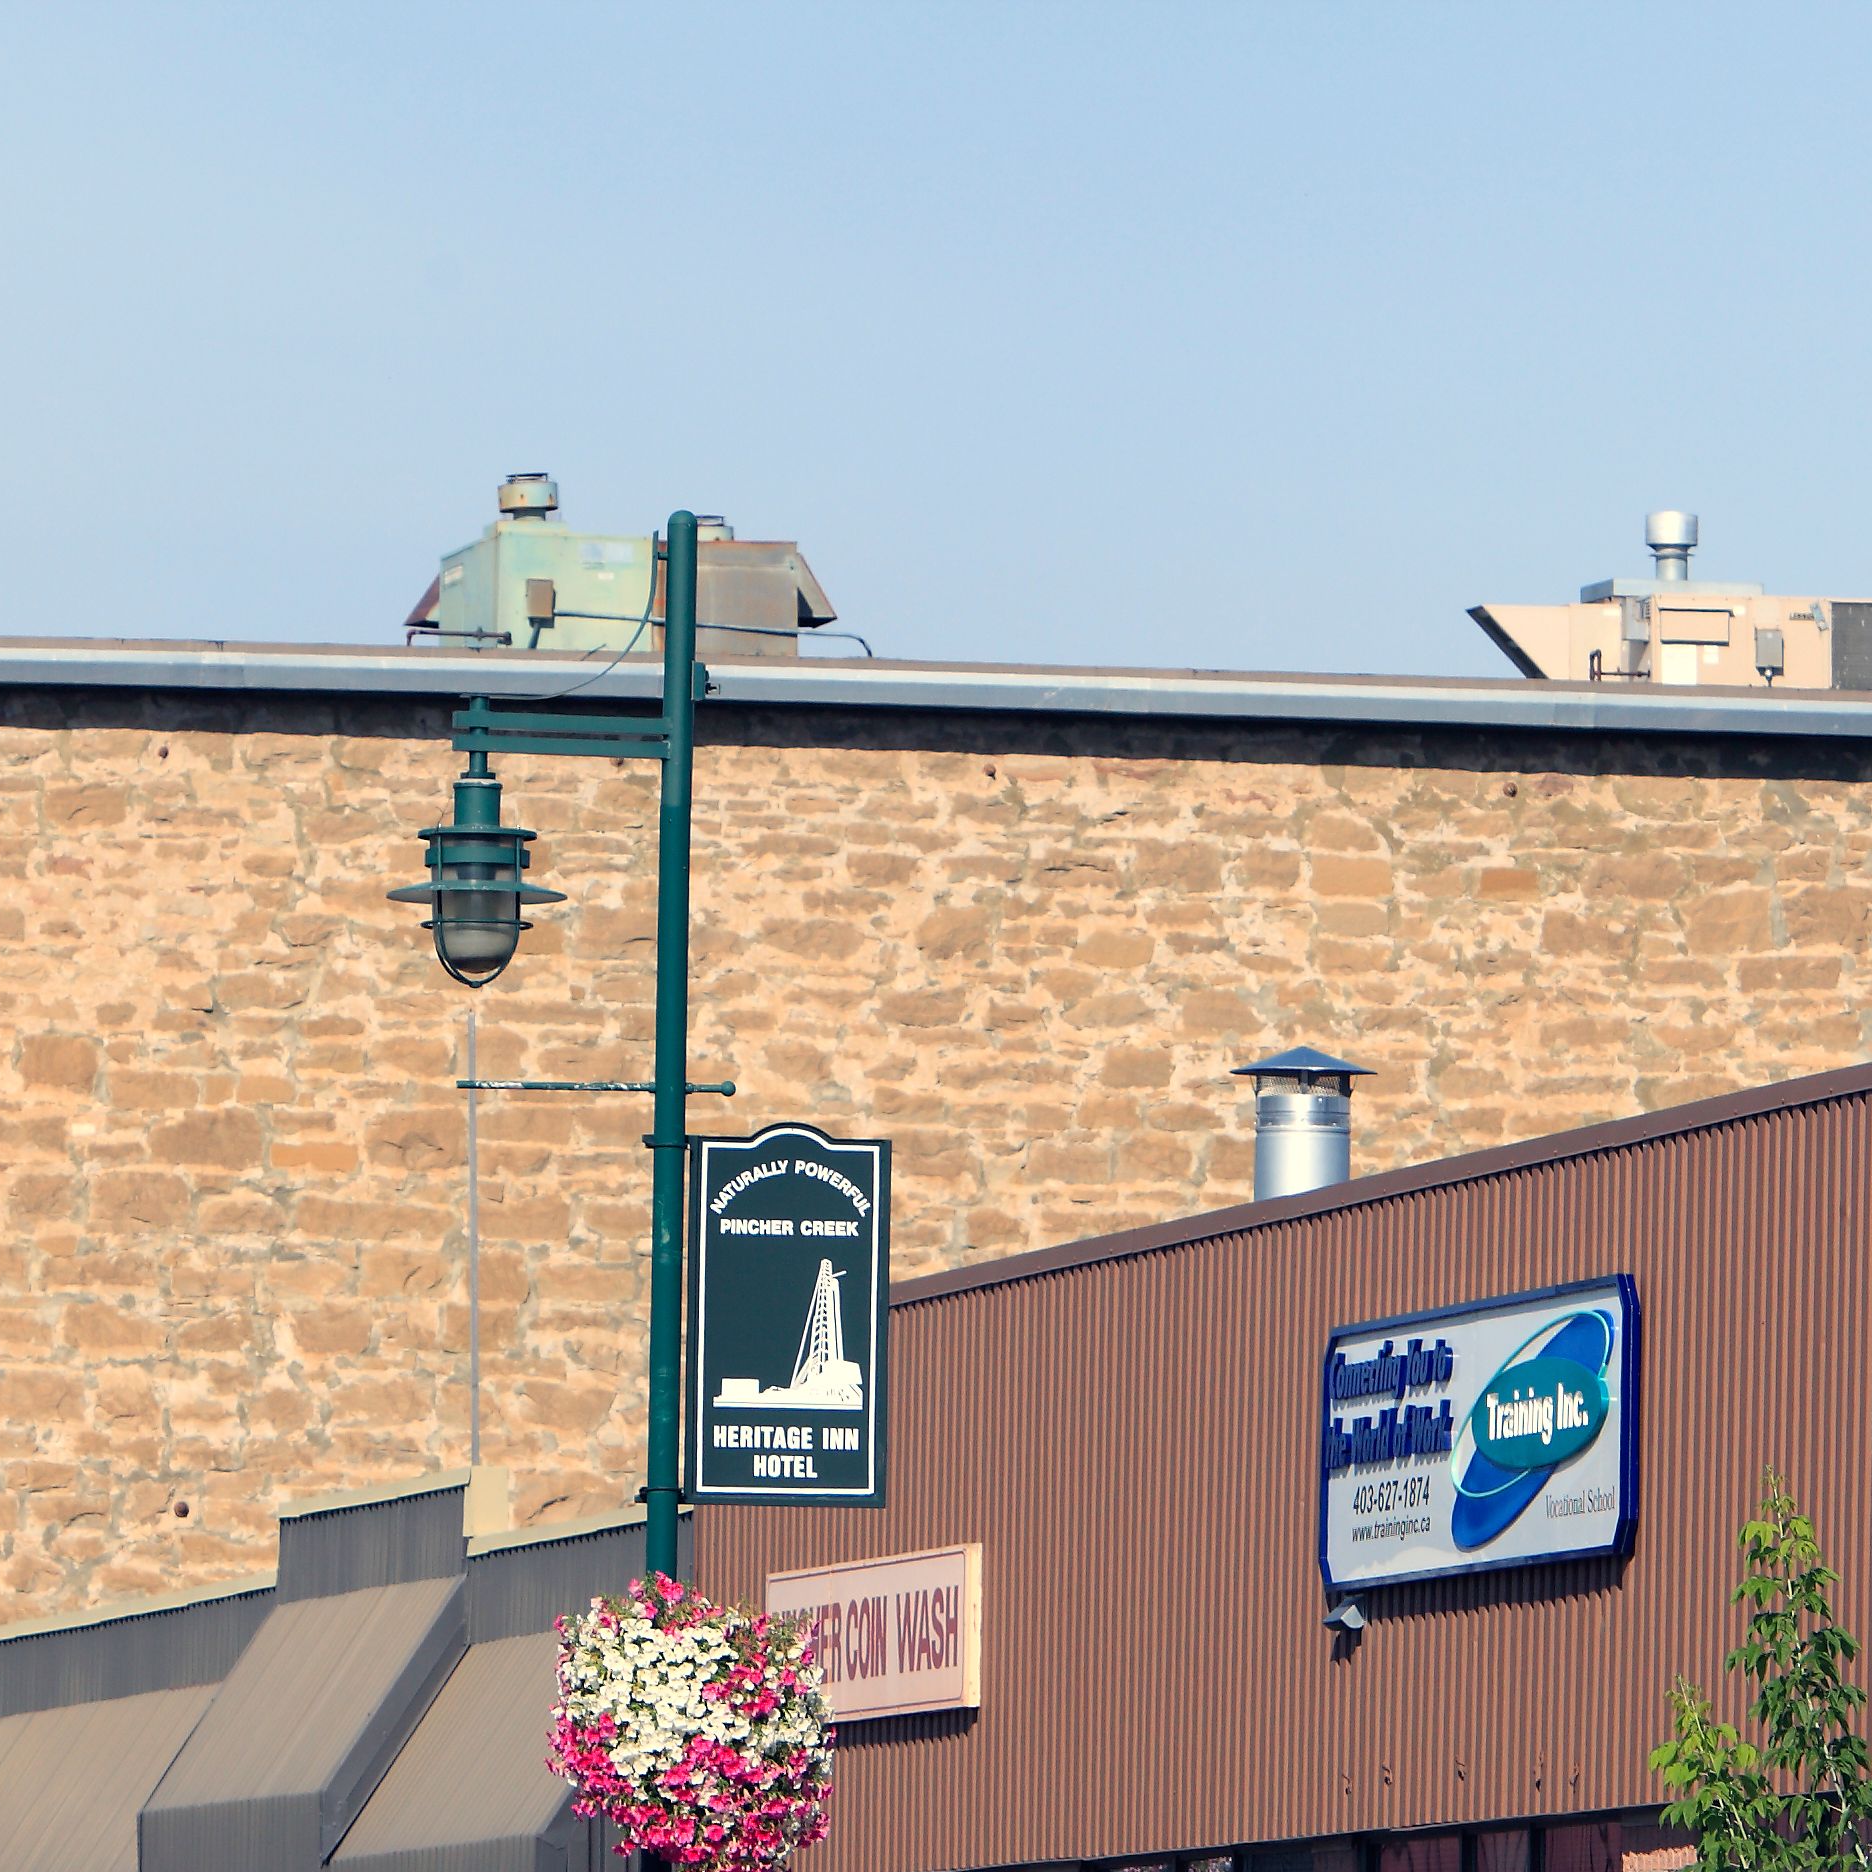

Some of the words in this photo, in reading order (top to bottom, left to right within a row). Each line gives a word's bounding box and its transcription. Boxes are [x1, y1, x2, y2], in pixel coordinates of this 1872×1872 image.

[709, 1160, 789, 1214] NATURALLY
[794, 1160, 872, 1217] POWERFUL
[720, 1218, 794, 1236] PINCHER
[800, 1220, 859, 1237] CREEK
[1328, 1340, 1407, 1400] Connecting
[1407, 1339, 1434, 1387] You
[1486, 1386, 1554, 1445] Training
[1556, 1382, 1589, 1430] Inc.
[713, 1425, 813, 1450] HERITAGE
[822, 1427, 859, 1451] INN
[753, 1455, 818, 1479] HOTEL
[1353, 1475, 1430, 1515] 403-627-1874
[1545, 1490, 1586, 1518] Vocational
[1587, 1484, 1615, 1512] School
[1352, 1514, 1431, 1542] www.traininginc.ca
[845, 1596, 888, 1681] COIN
[896, 1585, 959, 1674] WASH
